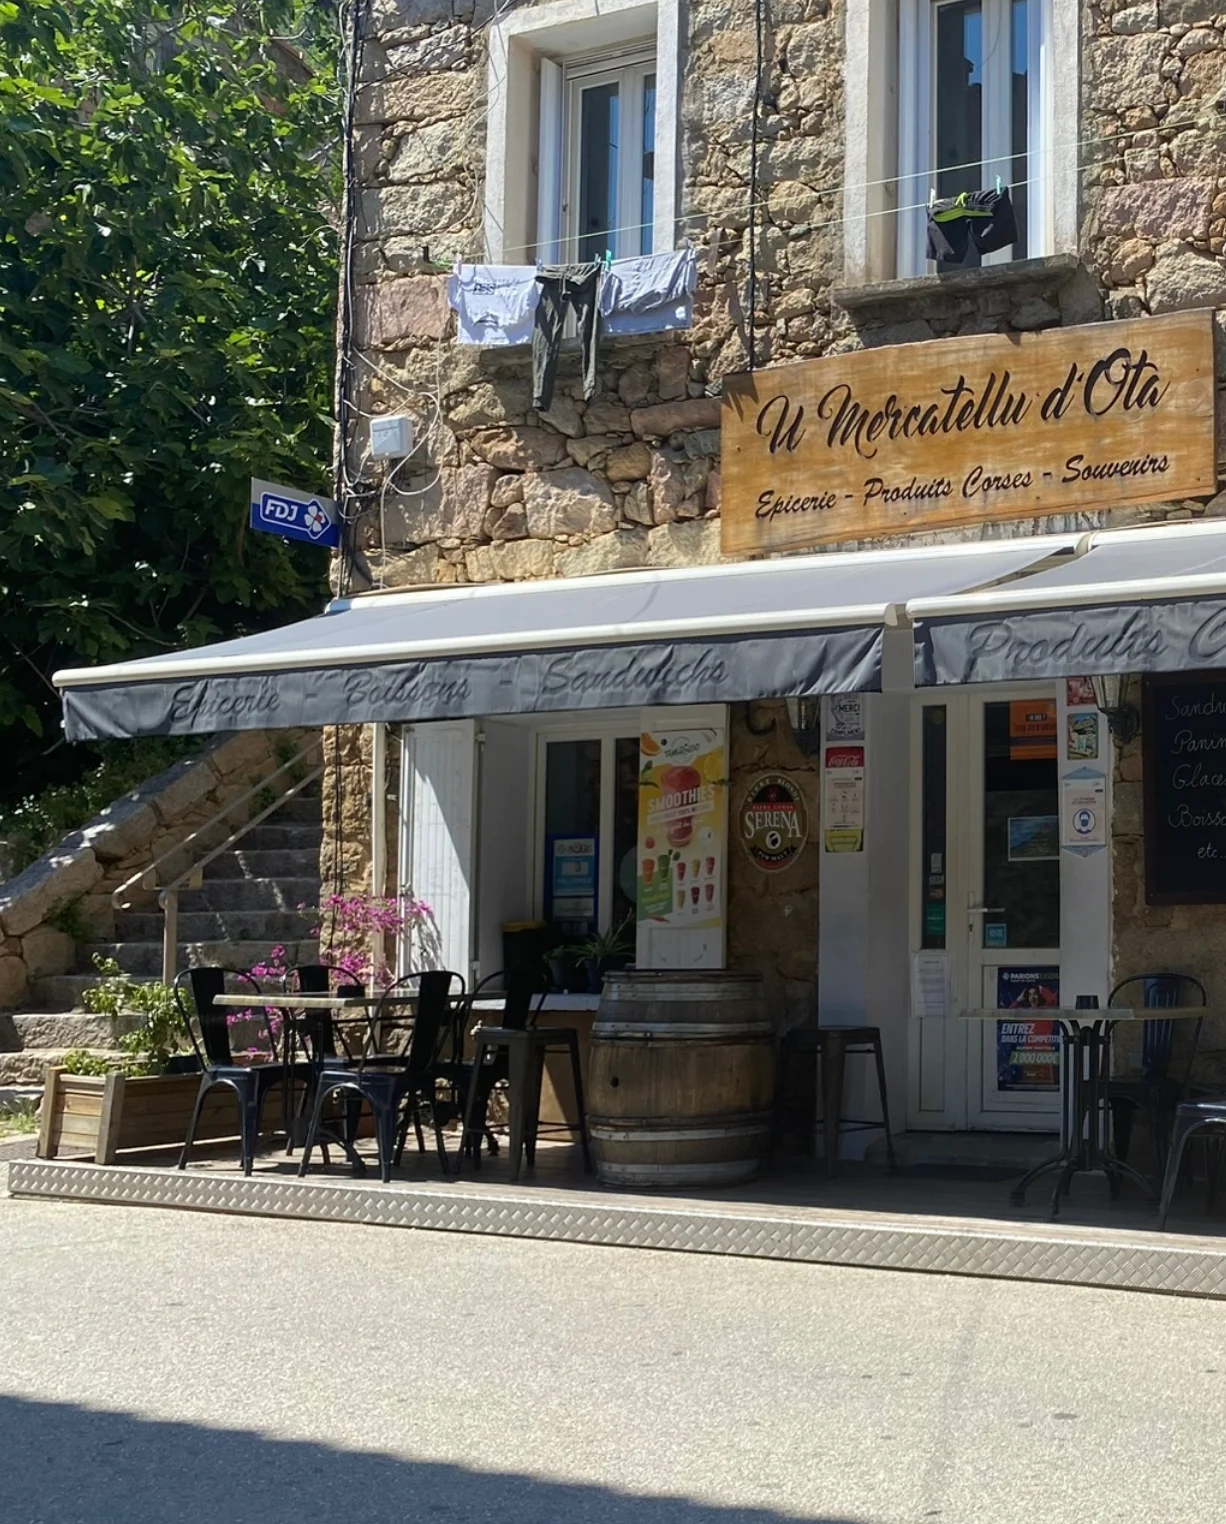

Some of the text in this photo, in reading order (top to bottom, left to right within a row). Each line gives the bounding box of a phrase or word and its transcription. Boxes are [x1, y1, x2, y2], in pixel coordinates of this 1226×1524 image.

[757, 347, 1172, 459] U Mercatellu d'Ota
[755, 489, 837, 522] Epicerie
[863, 477, 953, 507] Produits
[962, 466, 1033, 498] Corses
[1062, 454, 1171, 484] Souvenirs
[264, 499, 298, 521] FDJ
[963, 610, 1168, 682] Produits
[171, 683, 281, 726] Epicerie
[343, 671, 472, 707] Boissons
[541, 648, 730, 696] Sandwichs
[838, 704, 861, 713] MERCI
[647, 784, 716, 813] SMOOTHIES
[744, 810, 803, 839] SERENA
[1010, 972, 1039, 980] PARIONS
[1000, 1035, 1018, 1043] DANS
[1018, 1035, 1027, 1043] LA
[1001, 1023, 1036, 1034] ENTREZ
